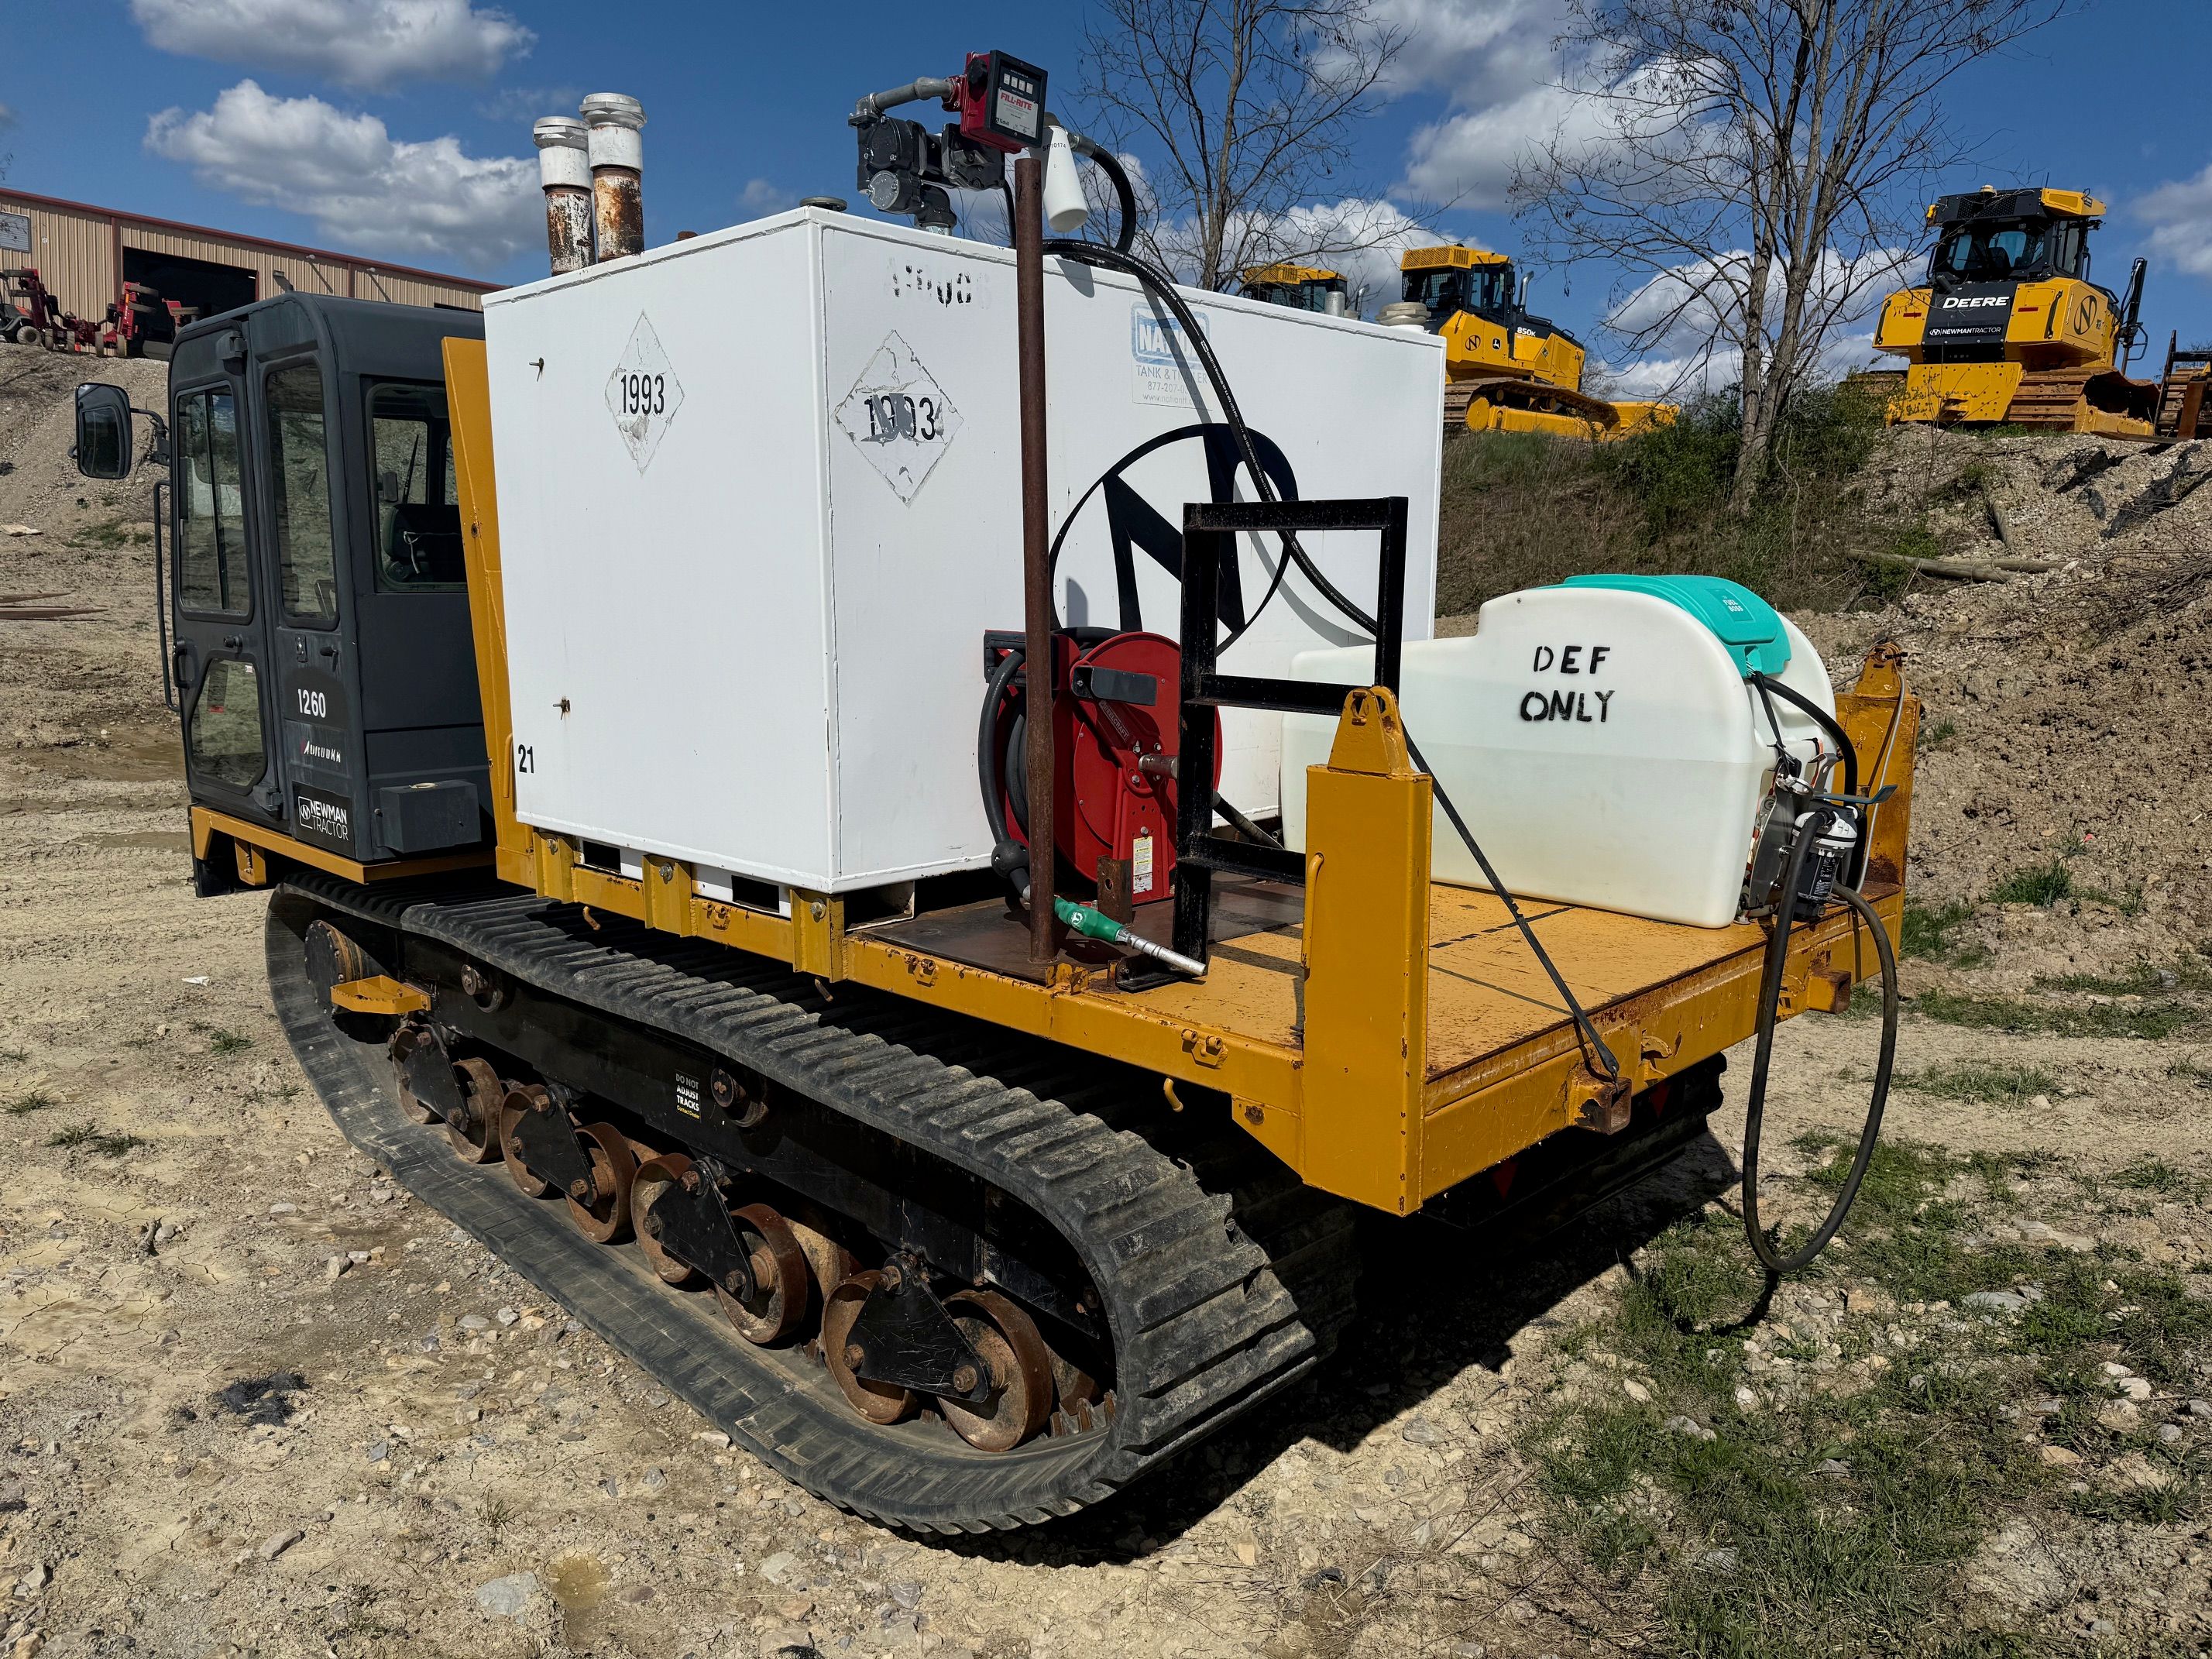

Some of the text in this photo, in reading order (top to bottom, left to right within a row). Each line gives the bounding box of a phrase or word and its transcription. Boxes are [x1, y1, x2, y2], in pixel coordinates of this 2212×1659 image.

[1001, 93, 1032, 110] FILL-RITE
[1942, 296, 2010, 309] DEERE
[1516, 326, 1536, 337] 850K
[1136, 365, 1162, 379] TANK
[1164, 369, 1171, 380] &
[620, 374, 665, 414] 1993
[1534, 646, 1610, 674] DEF
[298, 689, 326, 718] 1260
[1520, 690, 1615, 722] ONLY
[1103, 705, 1128, 737] REELCRAFT
[517, 744, 534, 774] 21
[310, 799, 348, 825] NEWMAN
[311, 815, 349, 841] TRACTOR
[675, 1073, 699, 1090] DO NOT
[676, 1085, 699, 1101] ADJUST
[676, 1094, 699, 1112] TRACKS
